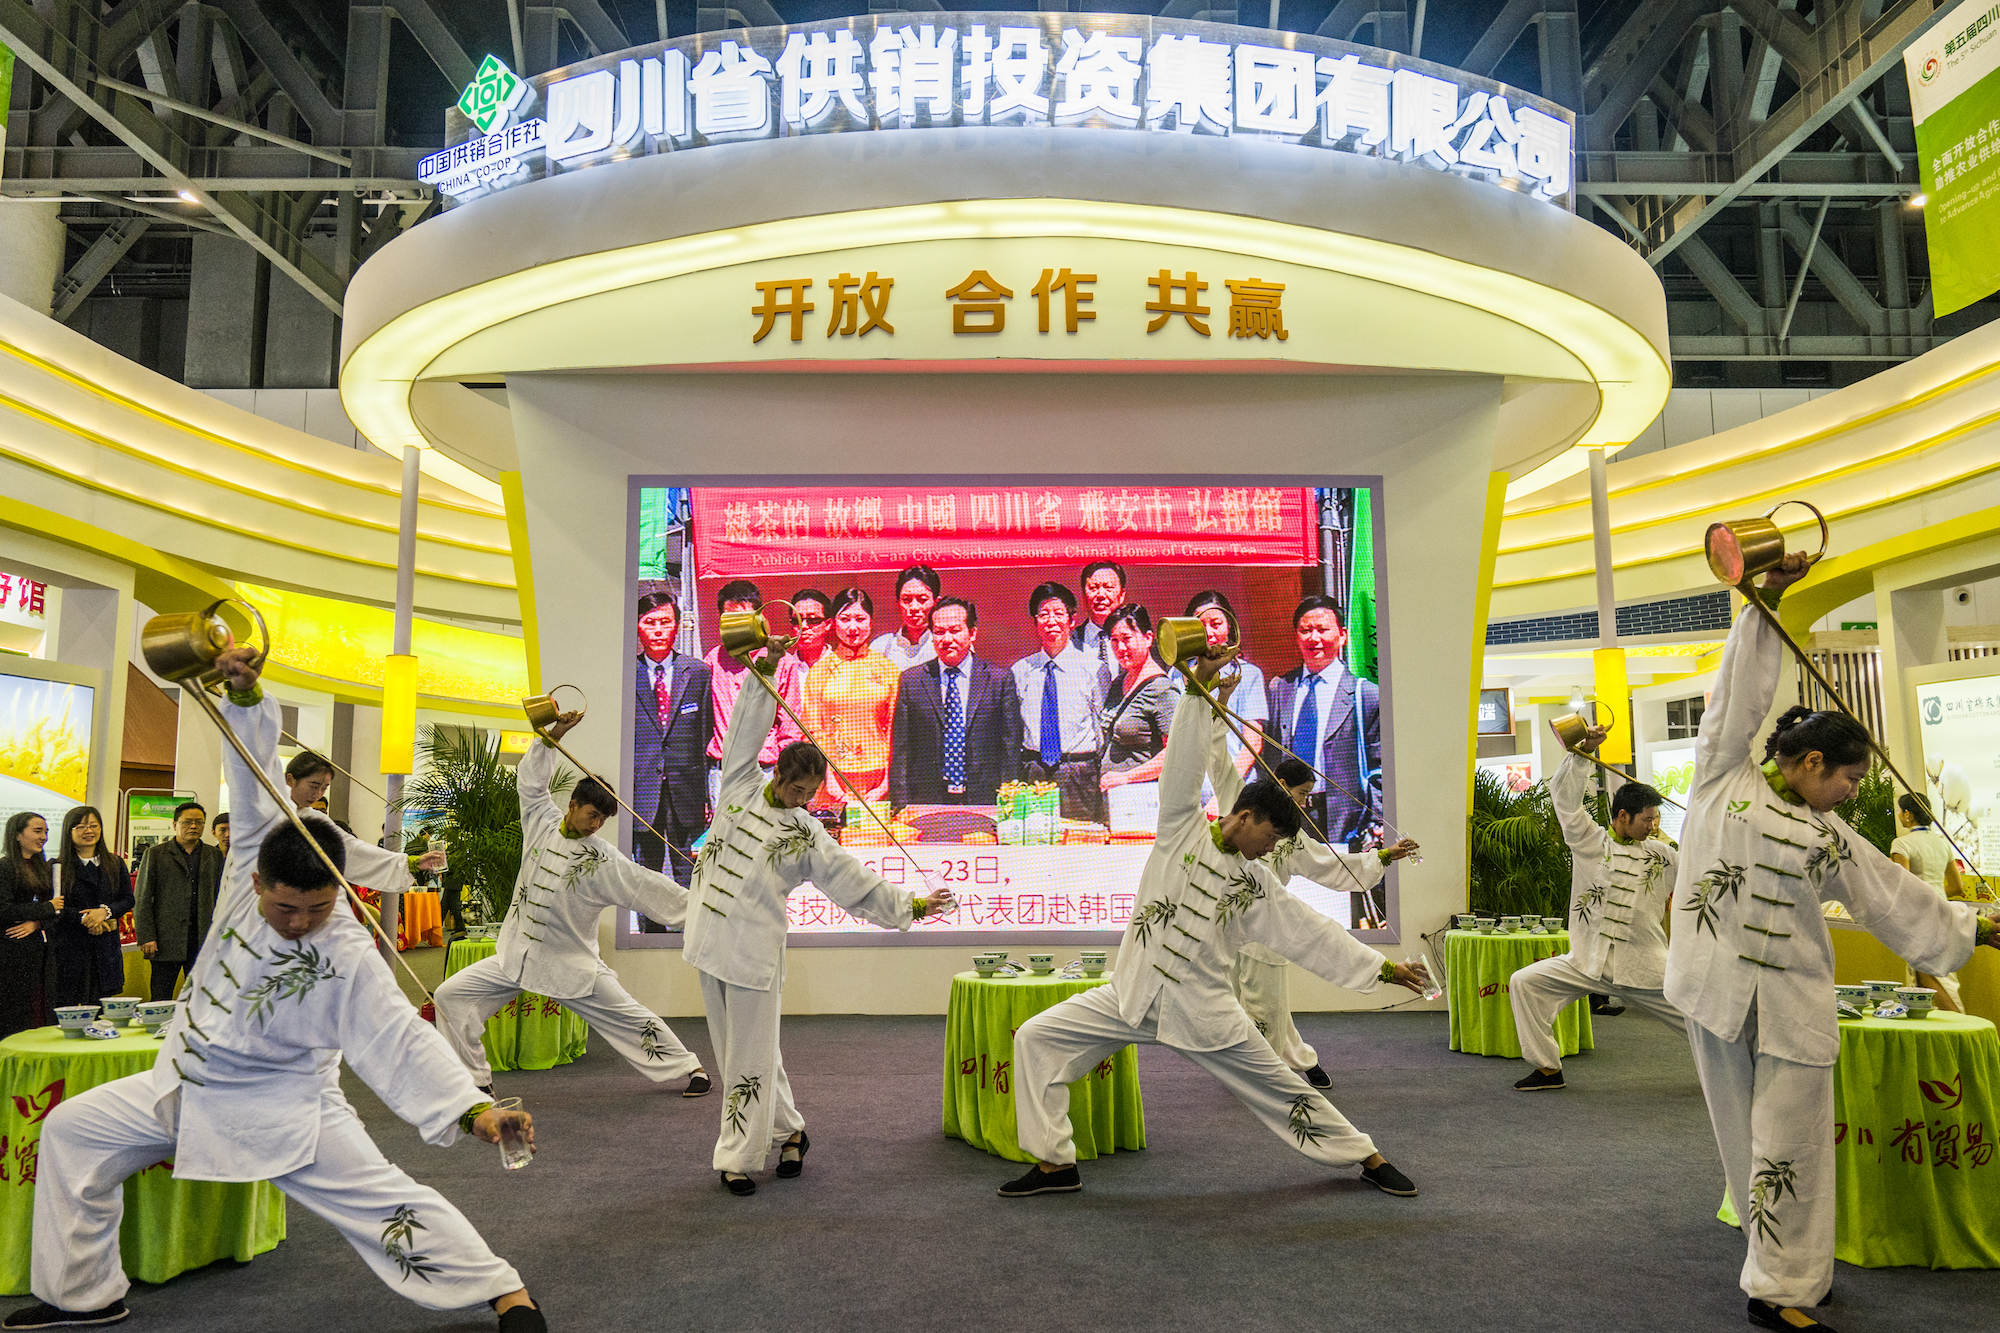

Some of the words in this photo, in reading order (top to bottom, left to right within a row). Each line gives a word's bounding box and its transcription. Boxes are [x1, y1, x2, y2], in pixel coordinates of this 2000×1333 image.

[546, 22, 1570, 197] 四川省供销投资集团有限公司
[419, 119, 540, 179] 中国供销合作社
[439, 173, 470, 193] CHINA
[476, 157, 511, 179] CO-OP
[1947, 196, 1979, 219] Advance
[751, 271, 895, 344] 开放
[945, 268, 1098, 334] 合作
[1145, 268, 1289, 341] 共赢
[970, 490, 1062, 534] 四川省
[1078, 489, 1172, 533] 雅安市
[751, 553, 810, 568] Publicity
[816, 551, 844, 564] Hall
[849, 549, 863, 564] of
[1161, 544, 1176, 557] of
[1181, 543, 1226, 557] Green
